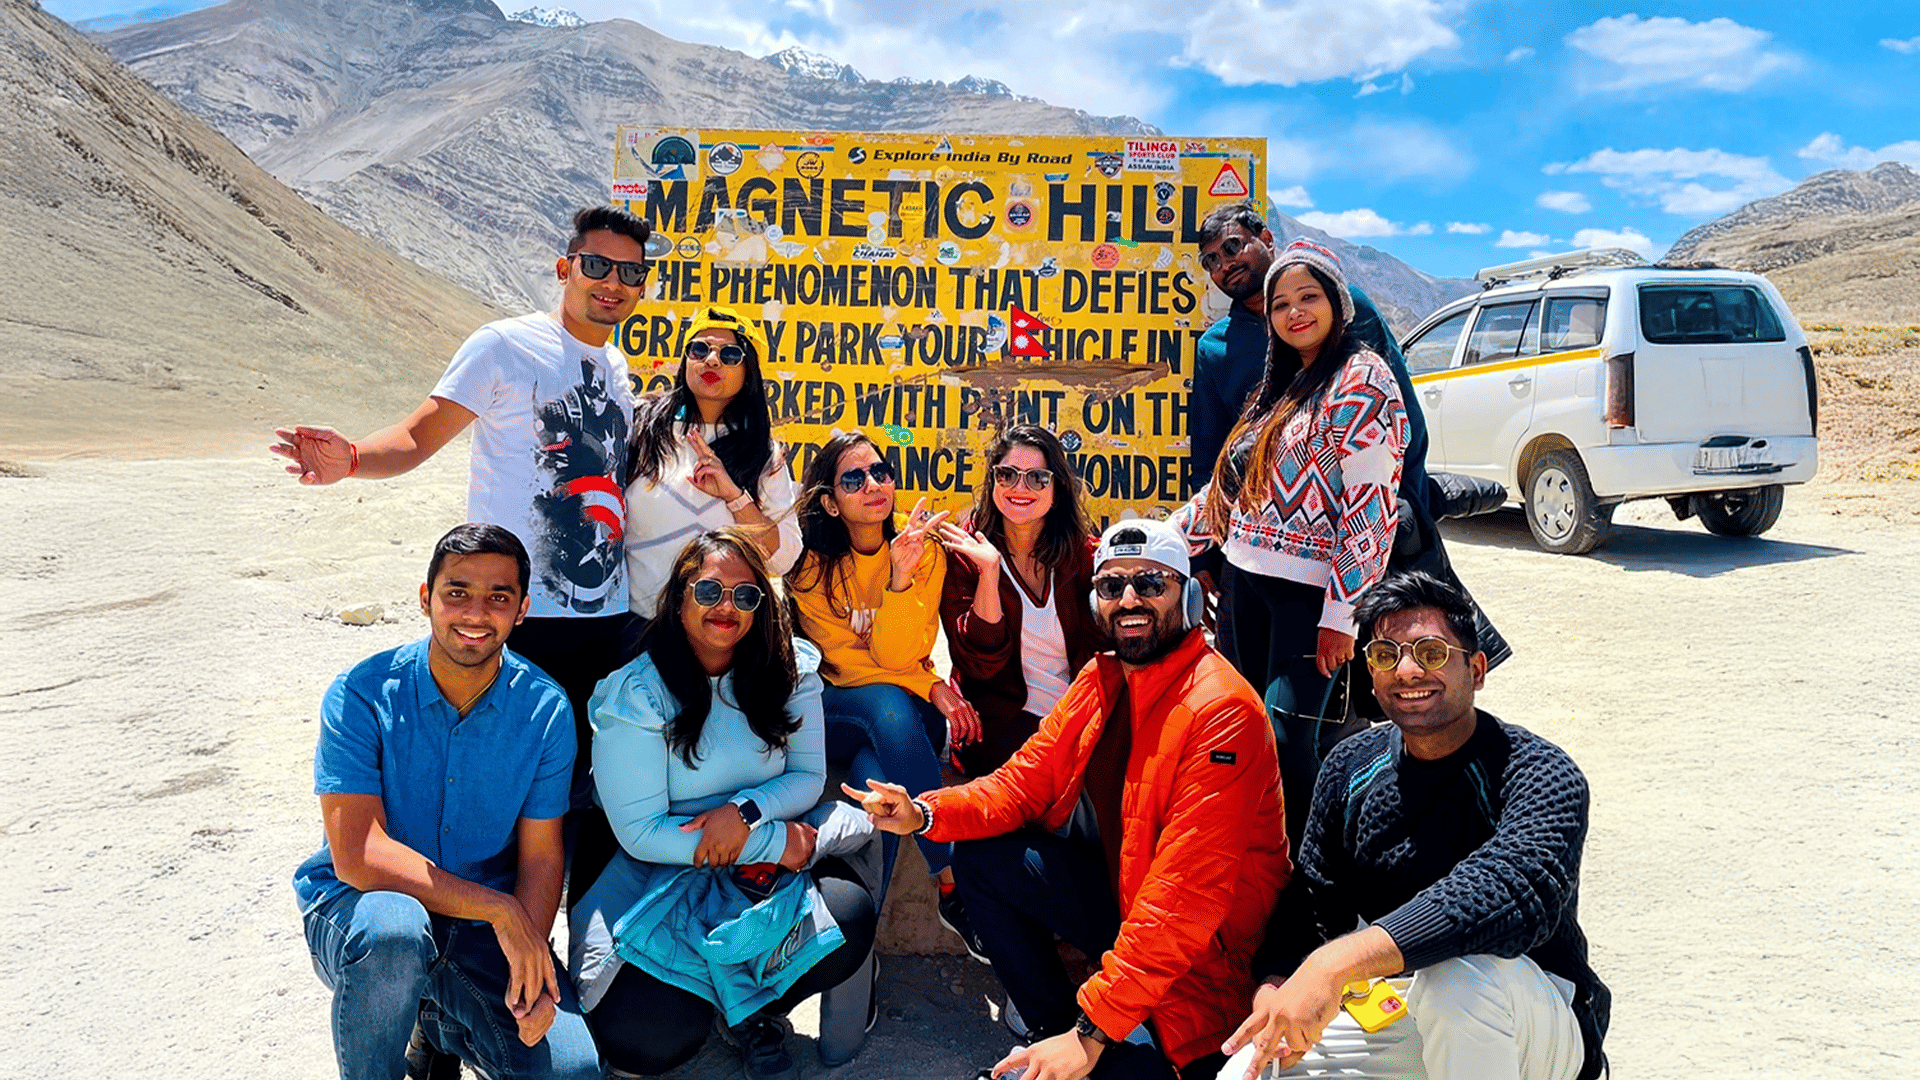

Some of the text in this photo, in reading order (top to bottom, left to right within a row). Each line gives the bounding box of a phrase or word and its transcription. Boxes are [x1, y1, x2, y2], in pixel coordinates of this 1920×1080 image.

[873, 149, 1073, 166] Explore India By Road
[1127, 141, 1178, 153] TILINGA
[613, 183, 648, 194] moto
[645, 175, 1202, 244] MAGNETIC HILL
[644, 260, 1197, 315] HE PHENOMENON THAT DEFIES
[794, 322, 885, 366] PARK
[898, 324, 988, 368] YOUR
[1147, 329, 1182, 375] IN
[763, 378, 845, 426] RKED
[854, 381, 947, 429] WITH
[1082, 392, 1136, 435] ON
[1145, 391, 1191, 436] TH
